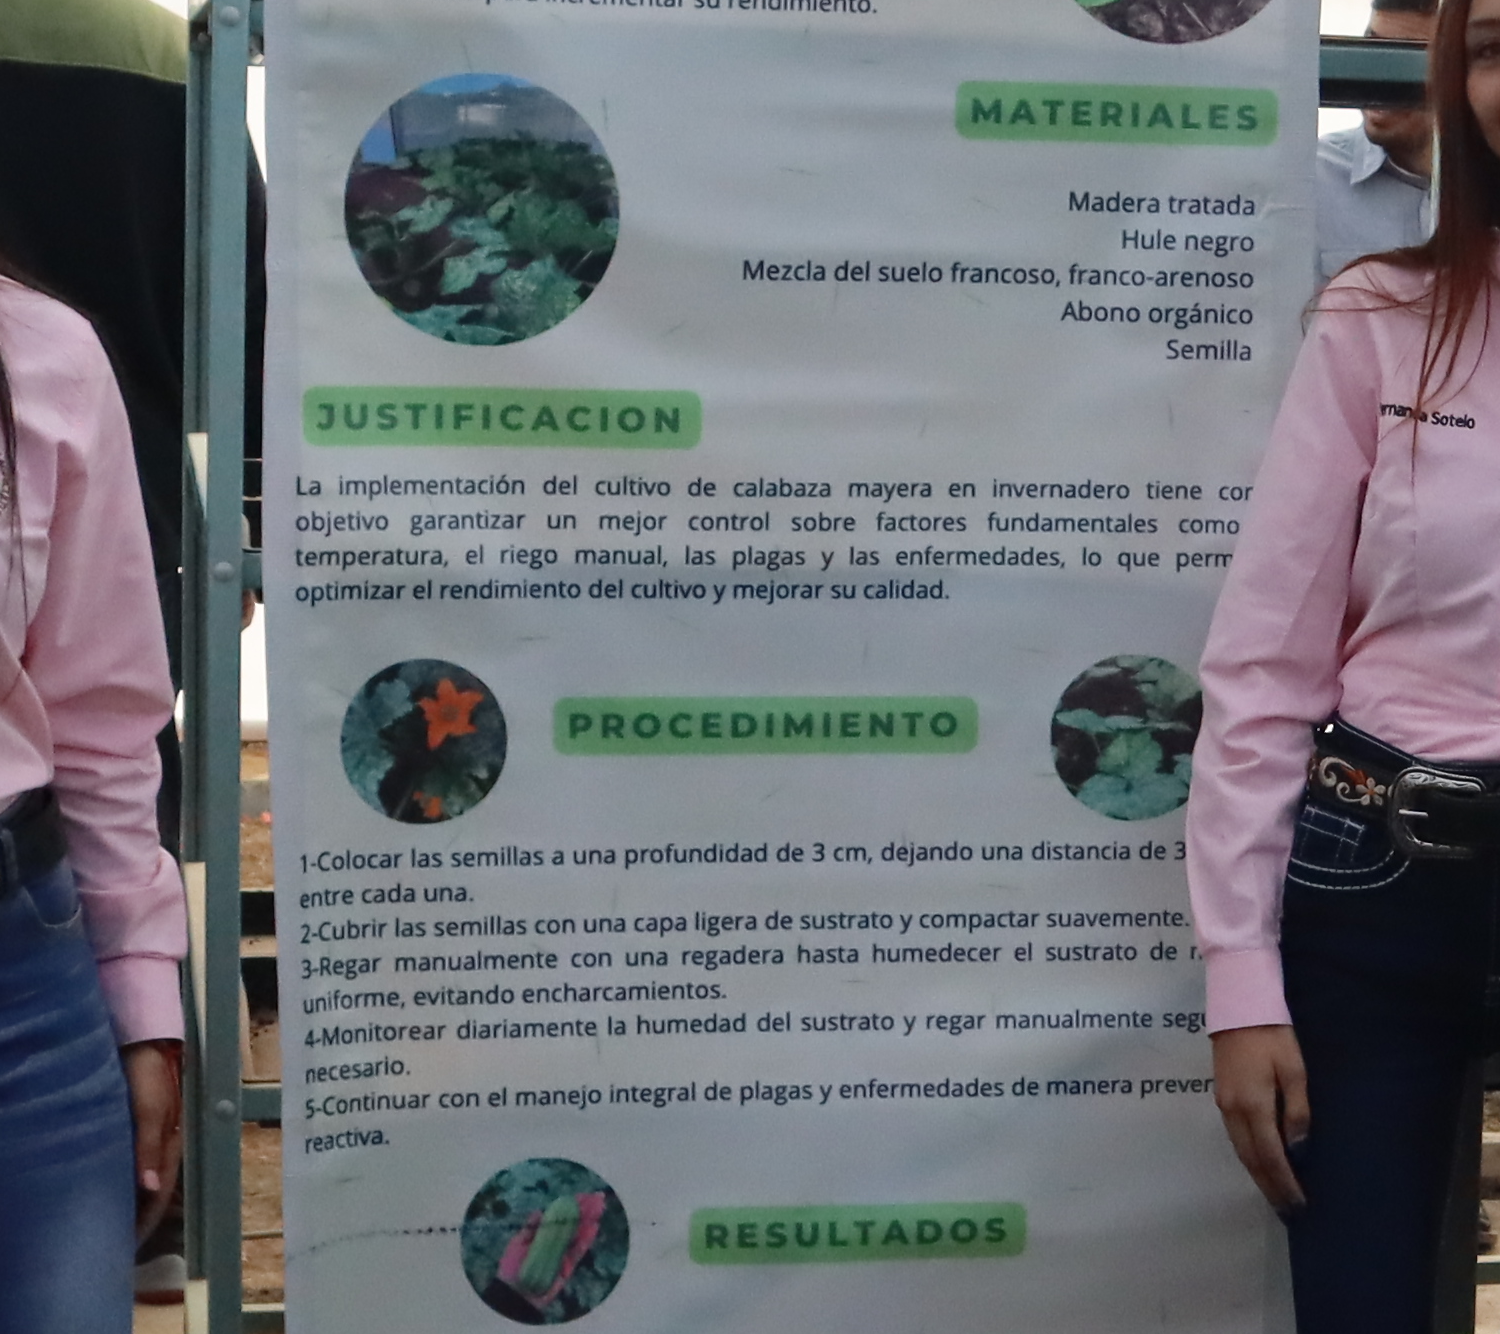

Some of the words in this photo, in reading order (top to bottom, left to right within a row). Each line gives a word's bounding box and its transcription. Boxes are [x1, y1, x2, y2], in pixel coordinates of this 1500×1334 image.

[971, 98, 1260, 132] MATERIALES
[1069, 191, 1160, 213] Madera
[1168, 194, 1255, 216] tratada
[1122, 229, 1176, 250] Hule
[1185, 235, 1254, 258] negro
[743, 260, 826, 281] Mezcla
[834, 260, 870, 282] del
[878, 262, 943, 283] suelo
[951, 262, 1060, 287] francoso,
[1069, 263, 1254, 288] franco-arenoso
[1061, 300, 1140, 323] Abono
[1148, 303, 1253, 329] orgánico
[1167, 339, 1251, 361] Semilla
[316, 401, 682, 434] JUSTIFICACION
[1431, 411, 1476, 431] Sotelo
[295, 511, 389, 537] objetivo
[410, 511, 526, 536] garantizar
[547, 515, 576, 529] un
[599, 512, 667, 536] mejor
[688, 511, 769, 531] control
[791, 512, 856, 532] sobre
[876, 511, 967, 532] factores
[987, 511, 1158, 533] fundamentales
[1178, 519, 1240, 535] como
[295, 581, 406, 607] optimizar
[413, 580, 432, 600] el
[440, 579, 581, 600] rendimiento
[588, 579, 623, 599] del
[631, 579, 706, 599] cultivo
[713, 585, 726, 605] y
[733, 581, 824, 605] mejorar
[831, 585, 856, 599] su
[863, 579, 949, 599] calidad.
[569, 712, 959, 740] PROCEDIMIENTO
[300, 889, 354, 909] entre
[361, 883, 416, 904] cada
[424, 887, 474, 902] una.
[301, 919, 387, 944] 2-Cubrir
[395, 918, 426, 937] las
[434, 915, 527, 937] semillas
[534, 919, 576, 934] con
[583, 918, 626, 933] una
[634, 916, 687, 937] capa
[695, 911, 757, 936] ligera
[765, 910, 793, 930] de
[800, 912, 893, 930] sustrato
[900, 914, 913, 934] y
[919, 911, 1040, 933] compactar
[1046, 910, 1189, 928] suavemente.
[303, 990, 405, 1015] uniforme,
[413, 985, 515, 1006] evitando
[522, 981, 726, 1004] encharcamientos.
[306, 1056, 410, 1084] necesario.
[305, 1130, 389, 1154] reactiva.
[705, 1218, 1007, 1249] RESULTADOS
